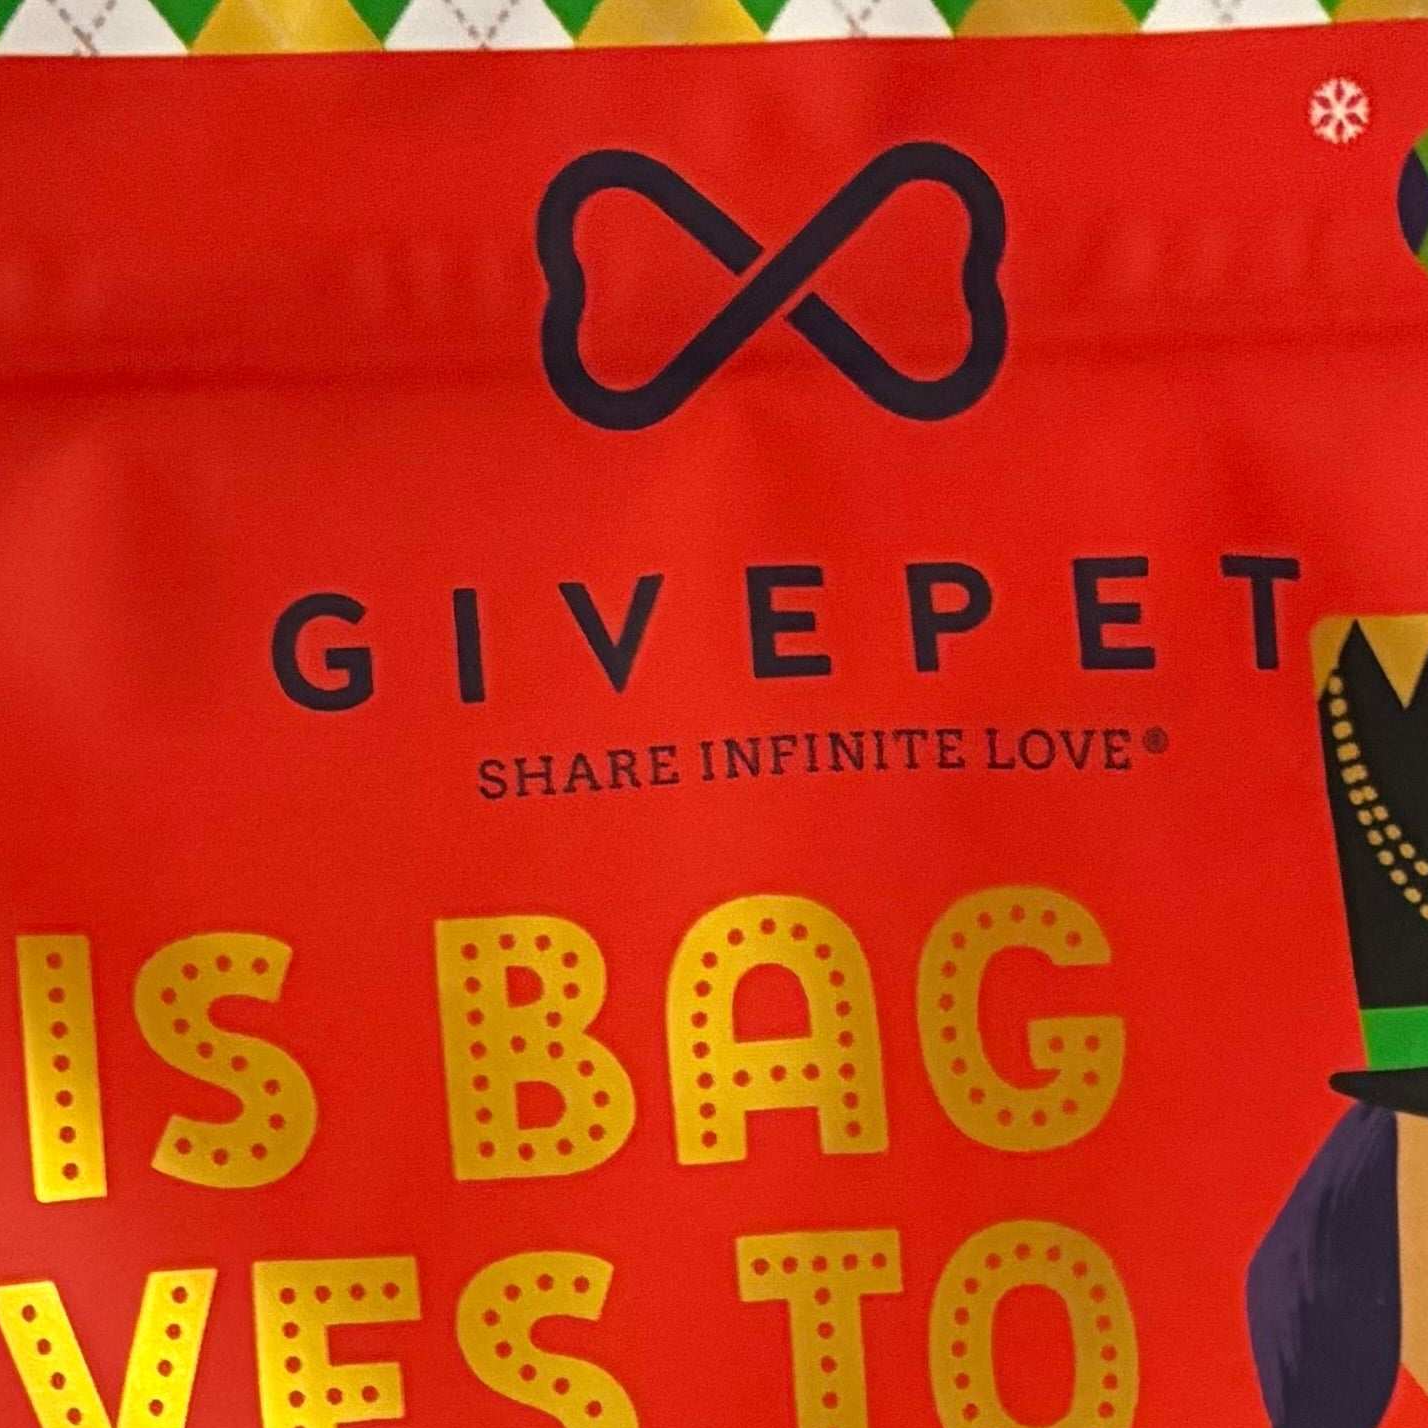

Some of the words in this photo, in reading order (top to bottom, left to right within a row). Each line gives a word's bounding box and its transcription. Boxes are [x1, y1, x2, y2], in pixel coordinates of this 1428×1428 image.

[271, 555, 1301, 712] GIVEPET
[478, 731, 681, 801] SHARE
[700, 728, 966, 783] INFINITE
[434, 886, 1126, 1183] BAG
